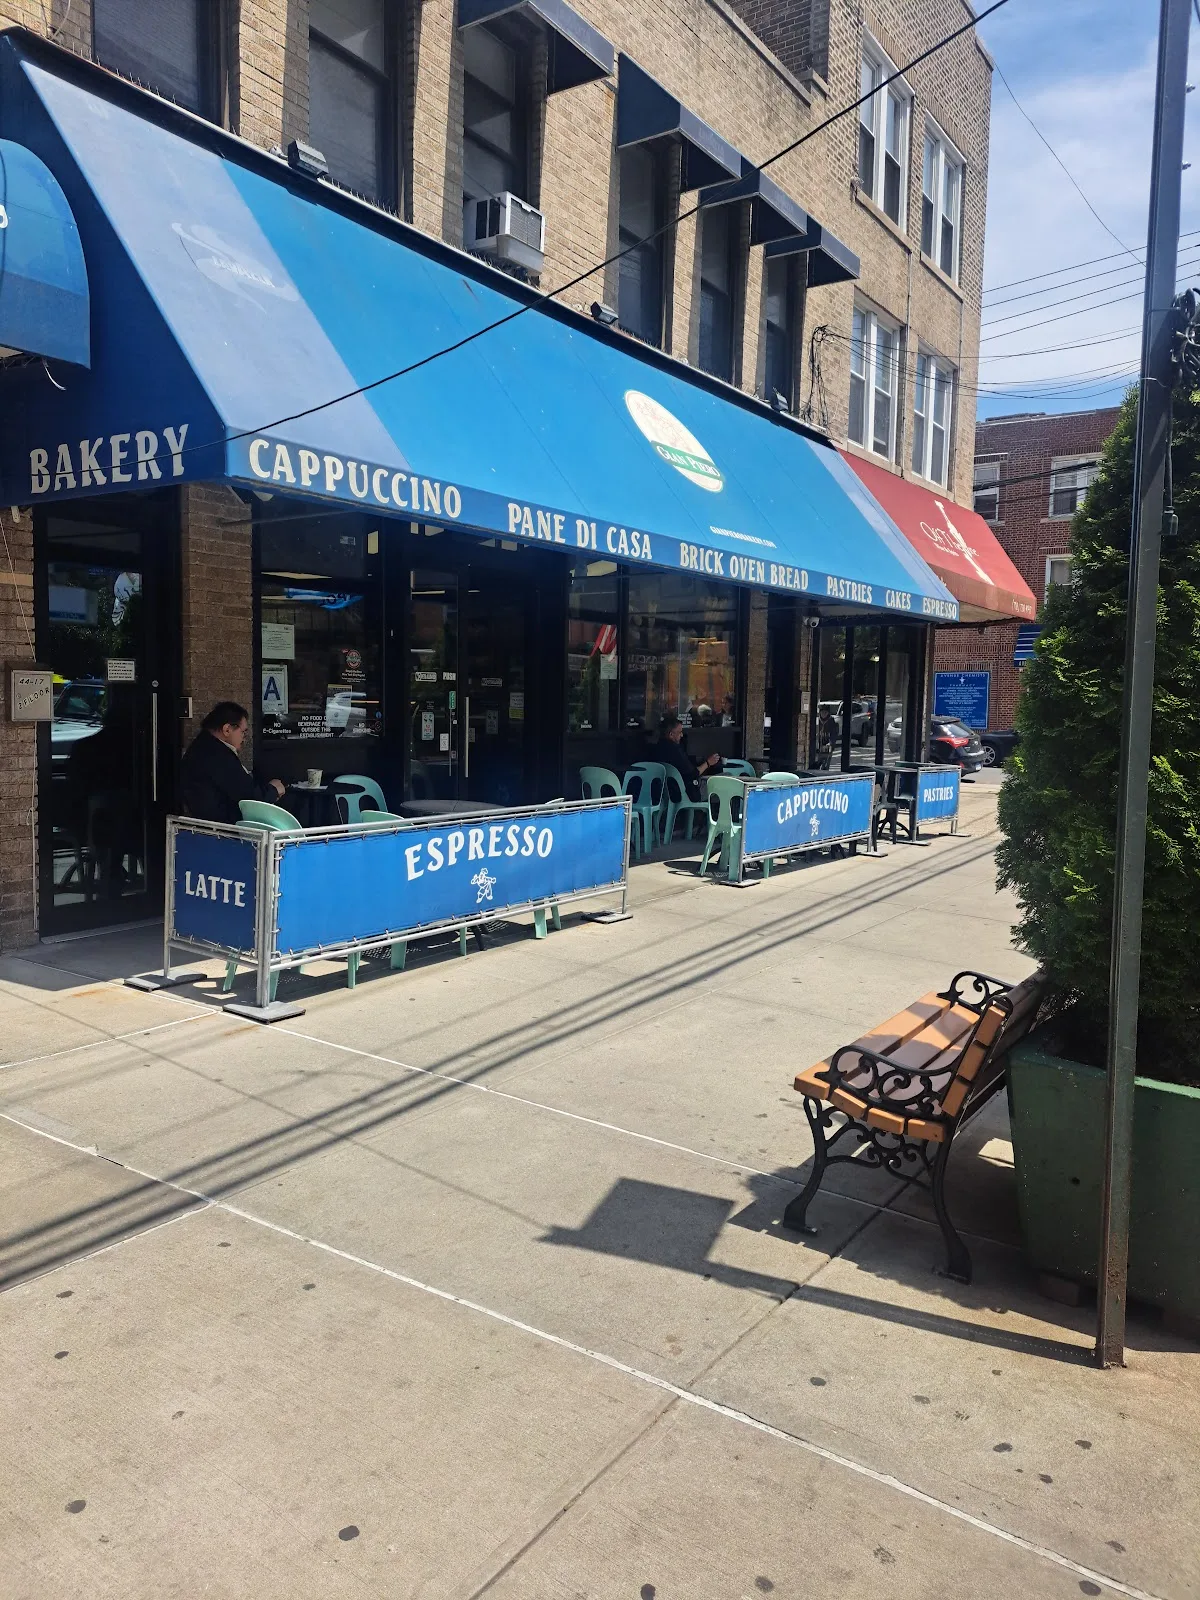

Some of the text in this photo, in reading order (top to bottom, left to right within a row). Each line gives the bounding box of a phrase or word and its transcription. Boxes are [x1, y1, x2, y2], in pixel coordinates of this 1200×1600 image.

[29, 423, 190, 495] BAKERY
[248, 438, 958, 620] CAPPUCCINO PANE DI CASA BRICK OVEN BREAD PASTRIES CAKES ESPRESSO
[263, 676, 280, 701] A
[776, 786, 954, 825] CAPPUCCINO PASTRIES
[404, 824, 554, 882] ESPRESSO
[184, 870, 247, 908] LATTE
